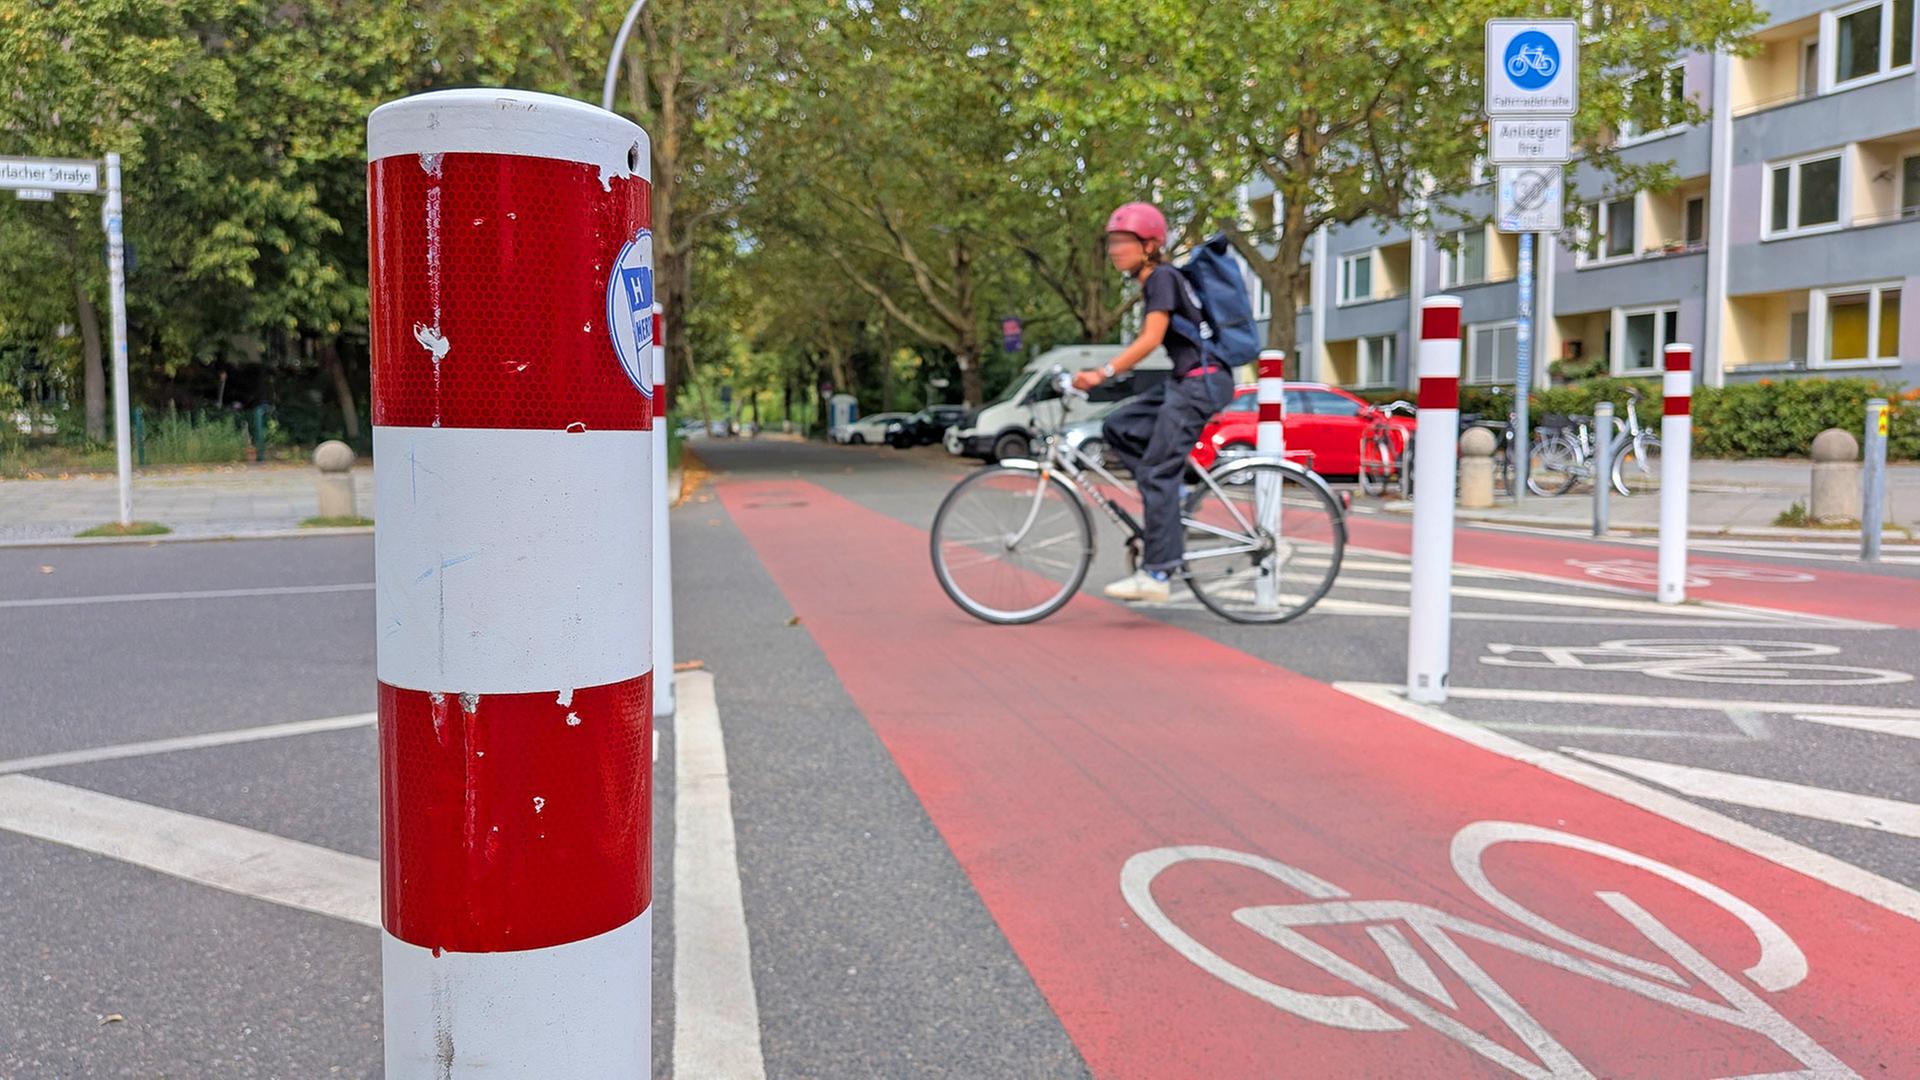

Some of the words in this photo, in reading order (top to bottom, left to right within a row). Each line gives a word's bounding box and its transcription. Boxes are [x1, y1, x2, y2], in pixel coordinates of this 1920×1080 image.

[1500, 125, 1561, 142] Anlieger
[1518, 141, 1544, 155] frei
[49, 167, 91, 185] Straße
